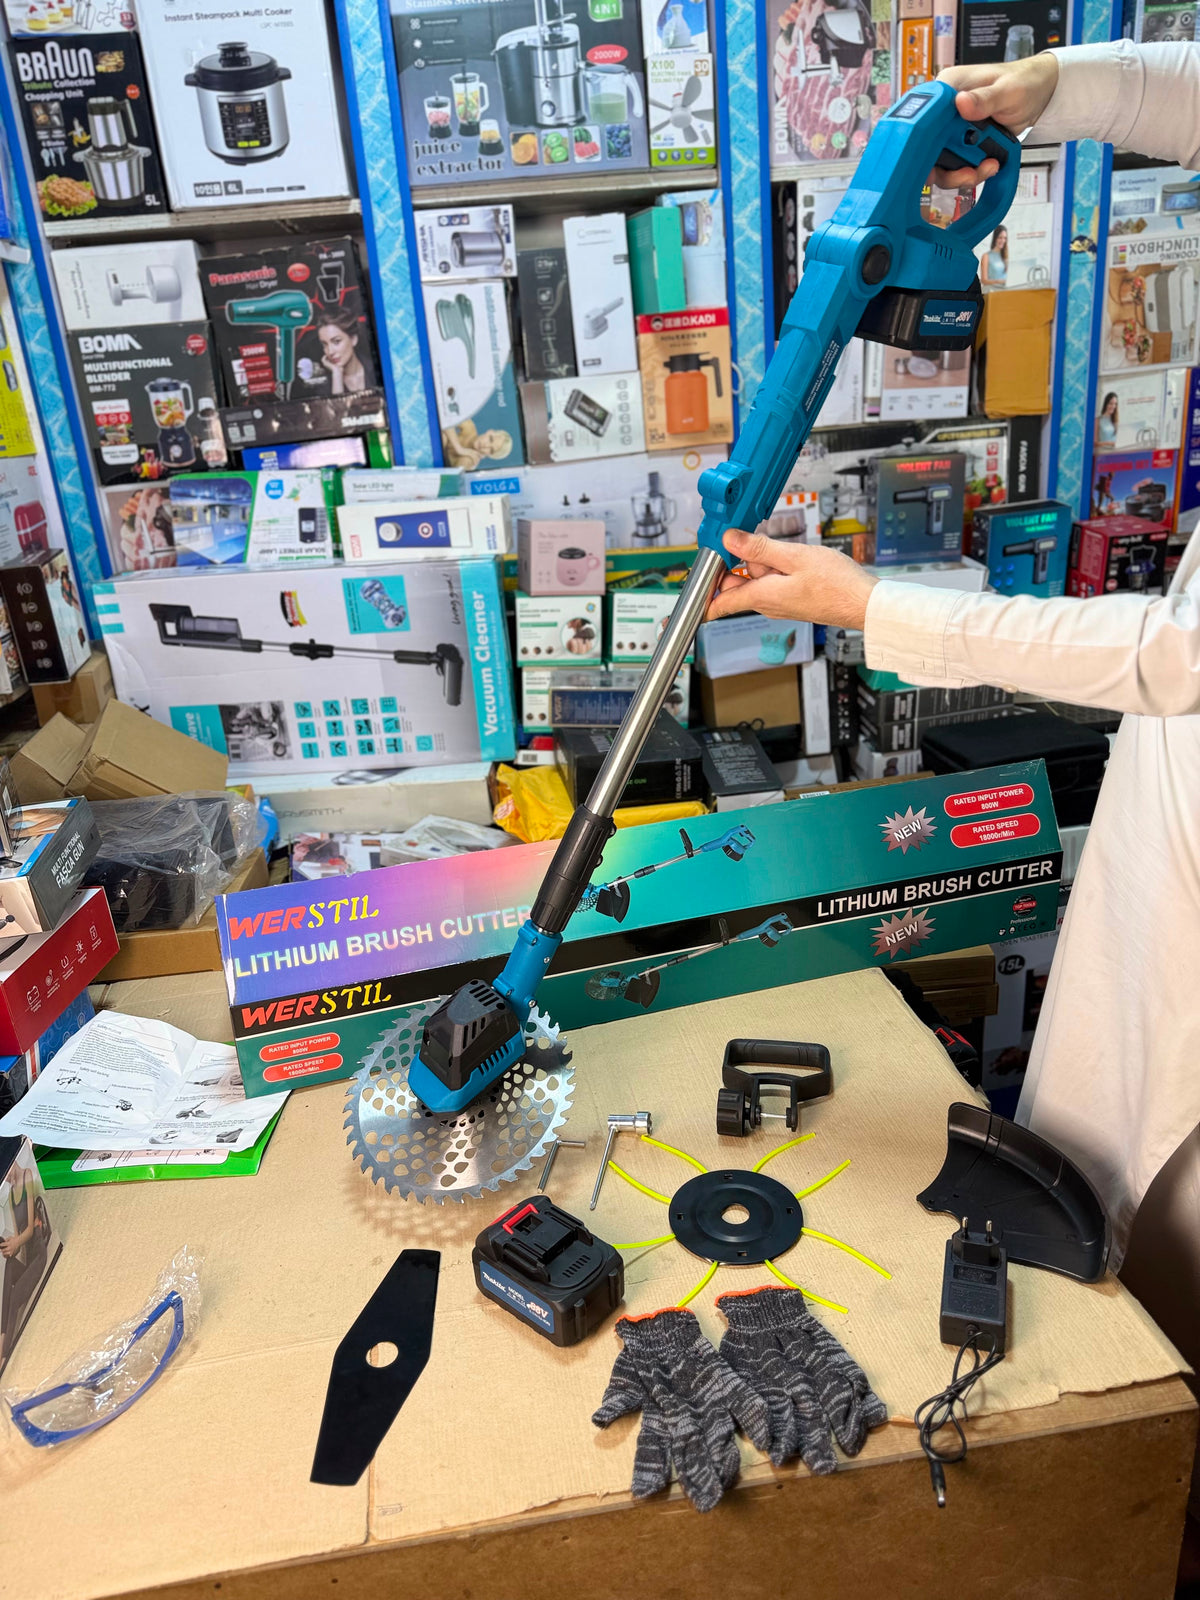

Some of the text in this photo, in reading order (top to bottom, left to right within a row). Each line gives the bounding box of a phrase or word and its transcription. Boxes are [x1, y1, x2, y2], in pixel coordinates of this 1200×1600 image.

[164, 8, 293, 22] Instant Steampack Multi Cooker
[16, 41, 96, 82] BRAUN
[651, 60, 675, 69] X100
[22, 78, 96, 91] Tribute Collection
[24, 89, 85, 102] Chopping Unit
[413, 139, 460, 160] juice
[416, 158, 502, 176] extractor
[145, 194, 160, 206] 5L
[1129, 237, 1199, 256] LUNCHBOX
[1160, 250, 1199, 261] COOKING
[208, 266, 277, 287] Panasonic
[260, 279, 278, 290] Dryer
[78, 334, 143, 354] BOMA
[84, 357, 173, 373] MULTIFUNCTIONAL
[86, 372, 131, 384] BLENDER
[896, 460, 952, 473] VIOLENT FAN
[1018, 440, 1028, 493] FASCIA GUN
[381, 482, 394, 490] light
[474, 480, 518, 494] VOLGA
[1005, 512, 1058, 528] VIOLENT FAN
[472, 591, 498, 736] Vacuum Cleaner
[953, 788, 1024, 805] RATED INPUT POWER
[981, 801, 999, 810] 800W
[893, 818, 922, 842] NEW
[972, 820, 1019, 833] RATED SPEED
[979, 830, 1015, 841] 18000r/Min
[50, 831, 81, 876] MULTI FUNCTIONAL
[56, 841, 85, 889] FASCIA GUN
[817, 860, 1053, 918] LITHIUM BRUSH CUTTER
[234, 905, 531, 978] LITHIUM BRUSH CUTTER
[885, 921, 919, 947] NEW
[1000, 957, 1024, 972] 15L
[268, 1045, 289, 1053] RATED
[308, 1036, 331, 1045] POWER
[283, 1058, 324, 1072] RATED SPEED
[288, 1066, 320, 1076] 18000r/Min
